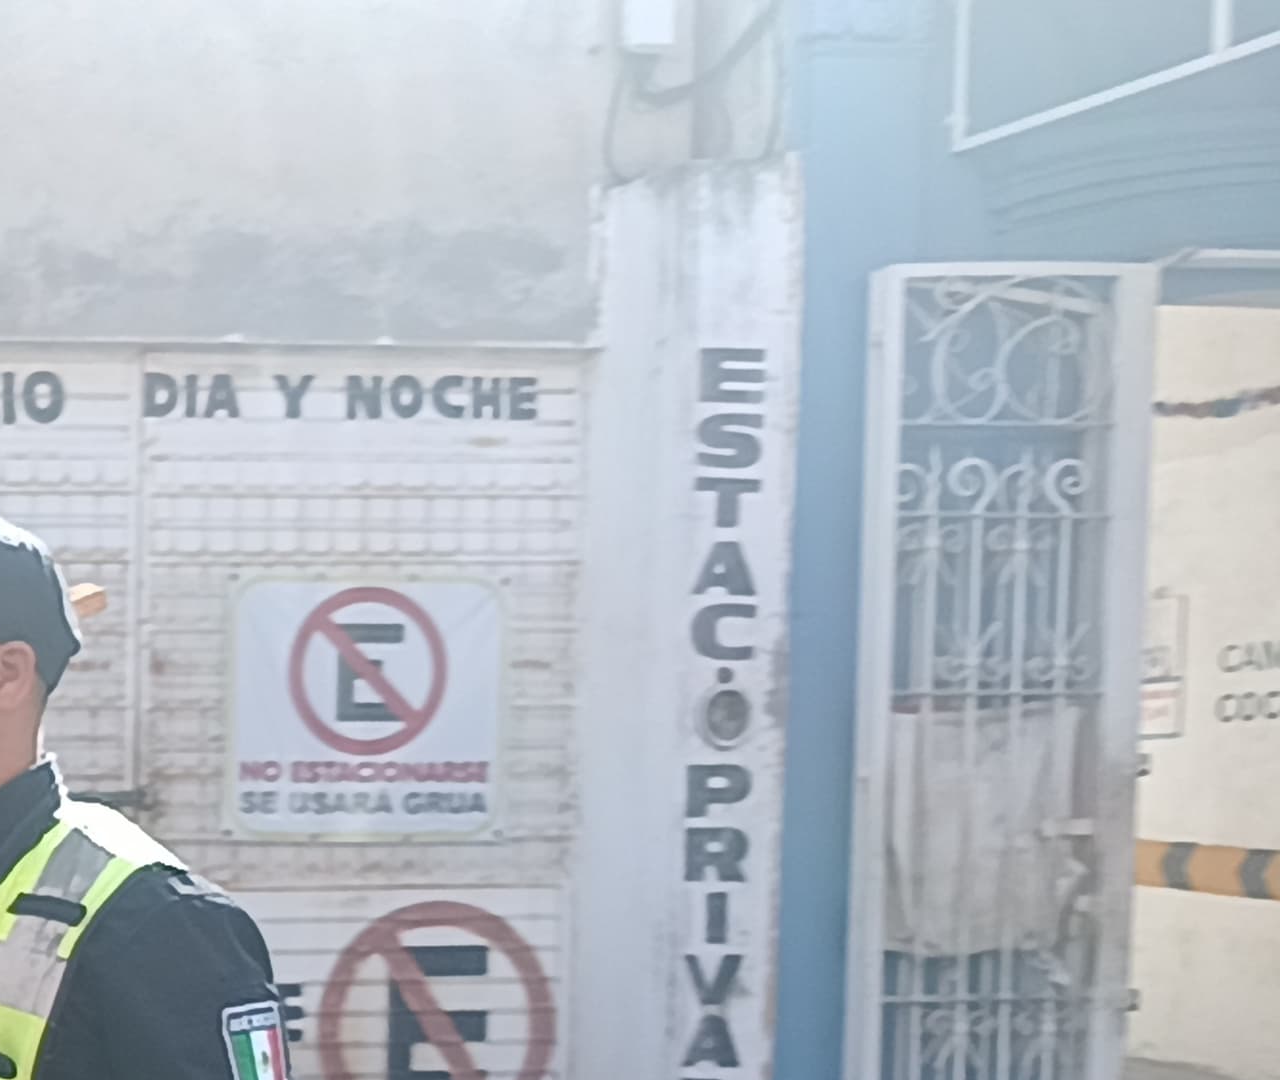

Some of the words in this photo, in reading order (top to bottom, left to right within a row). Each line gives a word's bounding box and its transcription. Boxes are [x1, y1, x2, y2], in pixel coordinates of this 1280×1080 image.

[143, 372, 240, 418] DIA
[274, 374, 315, 418] Y
[346, 374, 538, 420] NOCHE
[691, 347, 767, 684] ESTAC.
[239, 761, 282, 783] NO
[291, 761, 489, 784] ESTACIONARSE
[239, 791, 279, 814] SE
